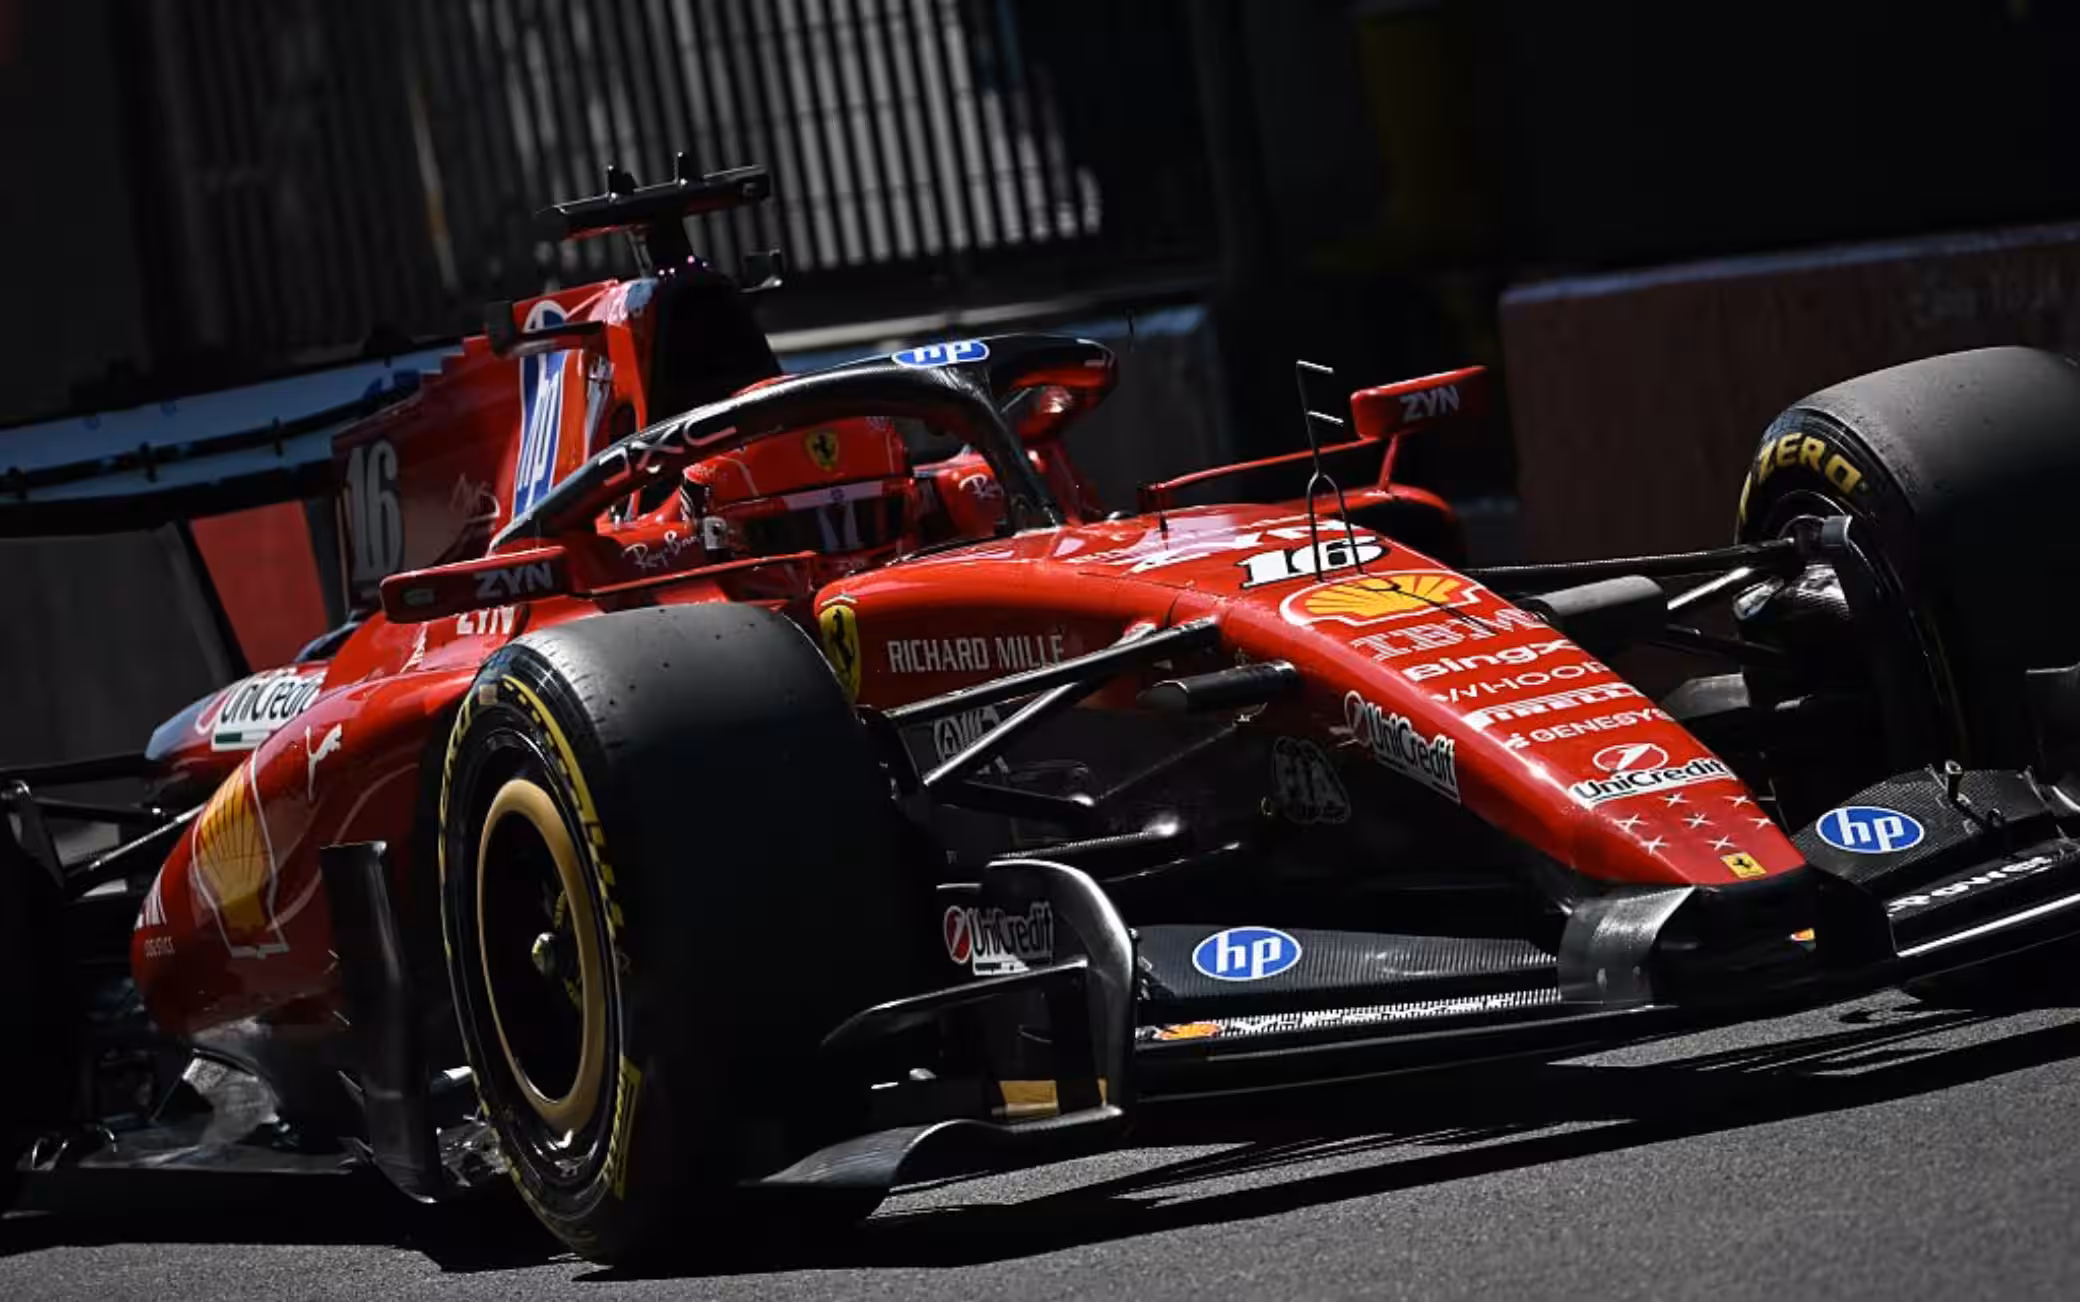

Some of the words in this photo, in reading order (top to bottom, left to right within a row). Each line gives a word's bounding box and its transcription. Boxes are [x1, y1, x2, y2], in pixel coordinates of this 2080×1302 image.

[1399, 384, 1460, 423] ZYN
[1759, 432, 1862, 495] ZERO
[344, 440, 403, 580] 16
[474, 560, 554, 598] ZYN
[1234, 534, 1390, 590] 16
[887, 638, 991, 674] RICHARD
[994, 633, 1065, 670] MILLE
[1350, 607, 1552, 662] IBM
[1402, 638, 1581, 682] BingX
[1367, 702, 1456, 787] UniCredit
[1574, 758, 1725, 799] UniCredit
[1836, 807, 1905, 851] hp
[970, 904, 1052, 957] UniCredit
[1215, 931, 1281, 978] hp
